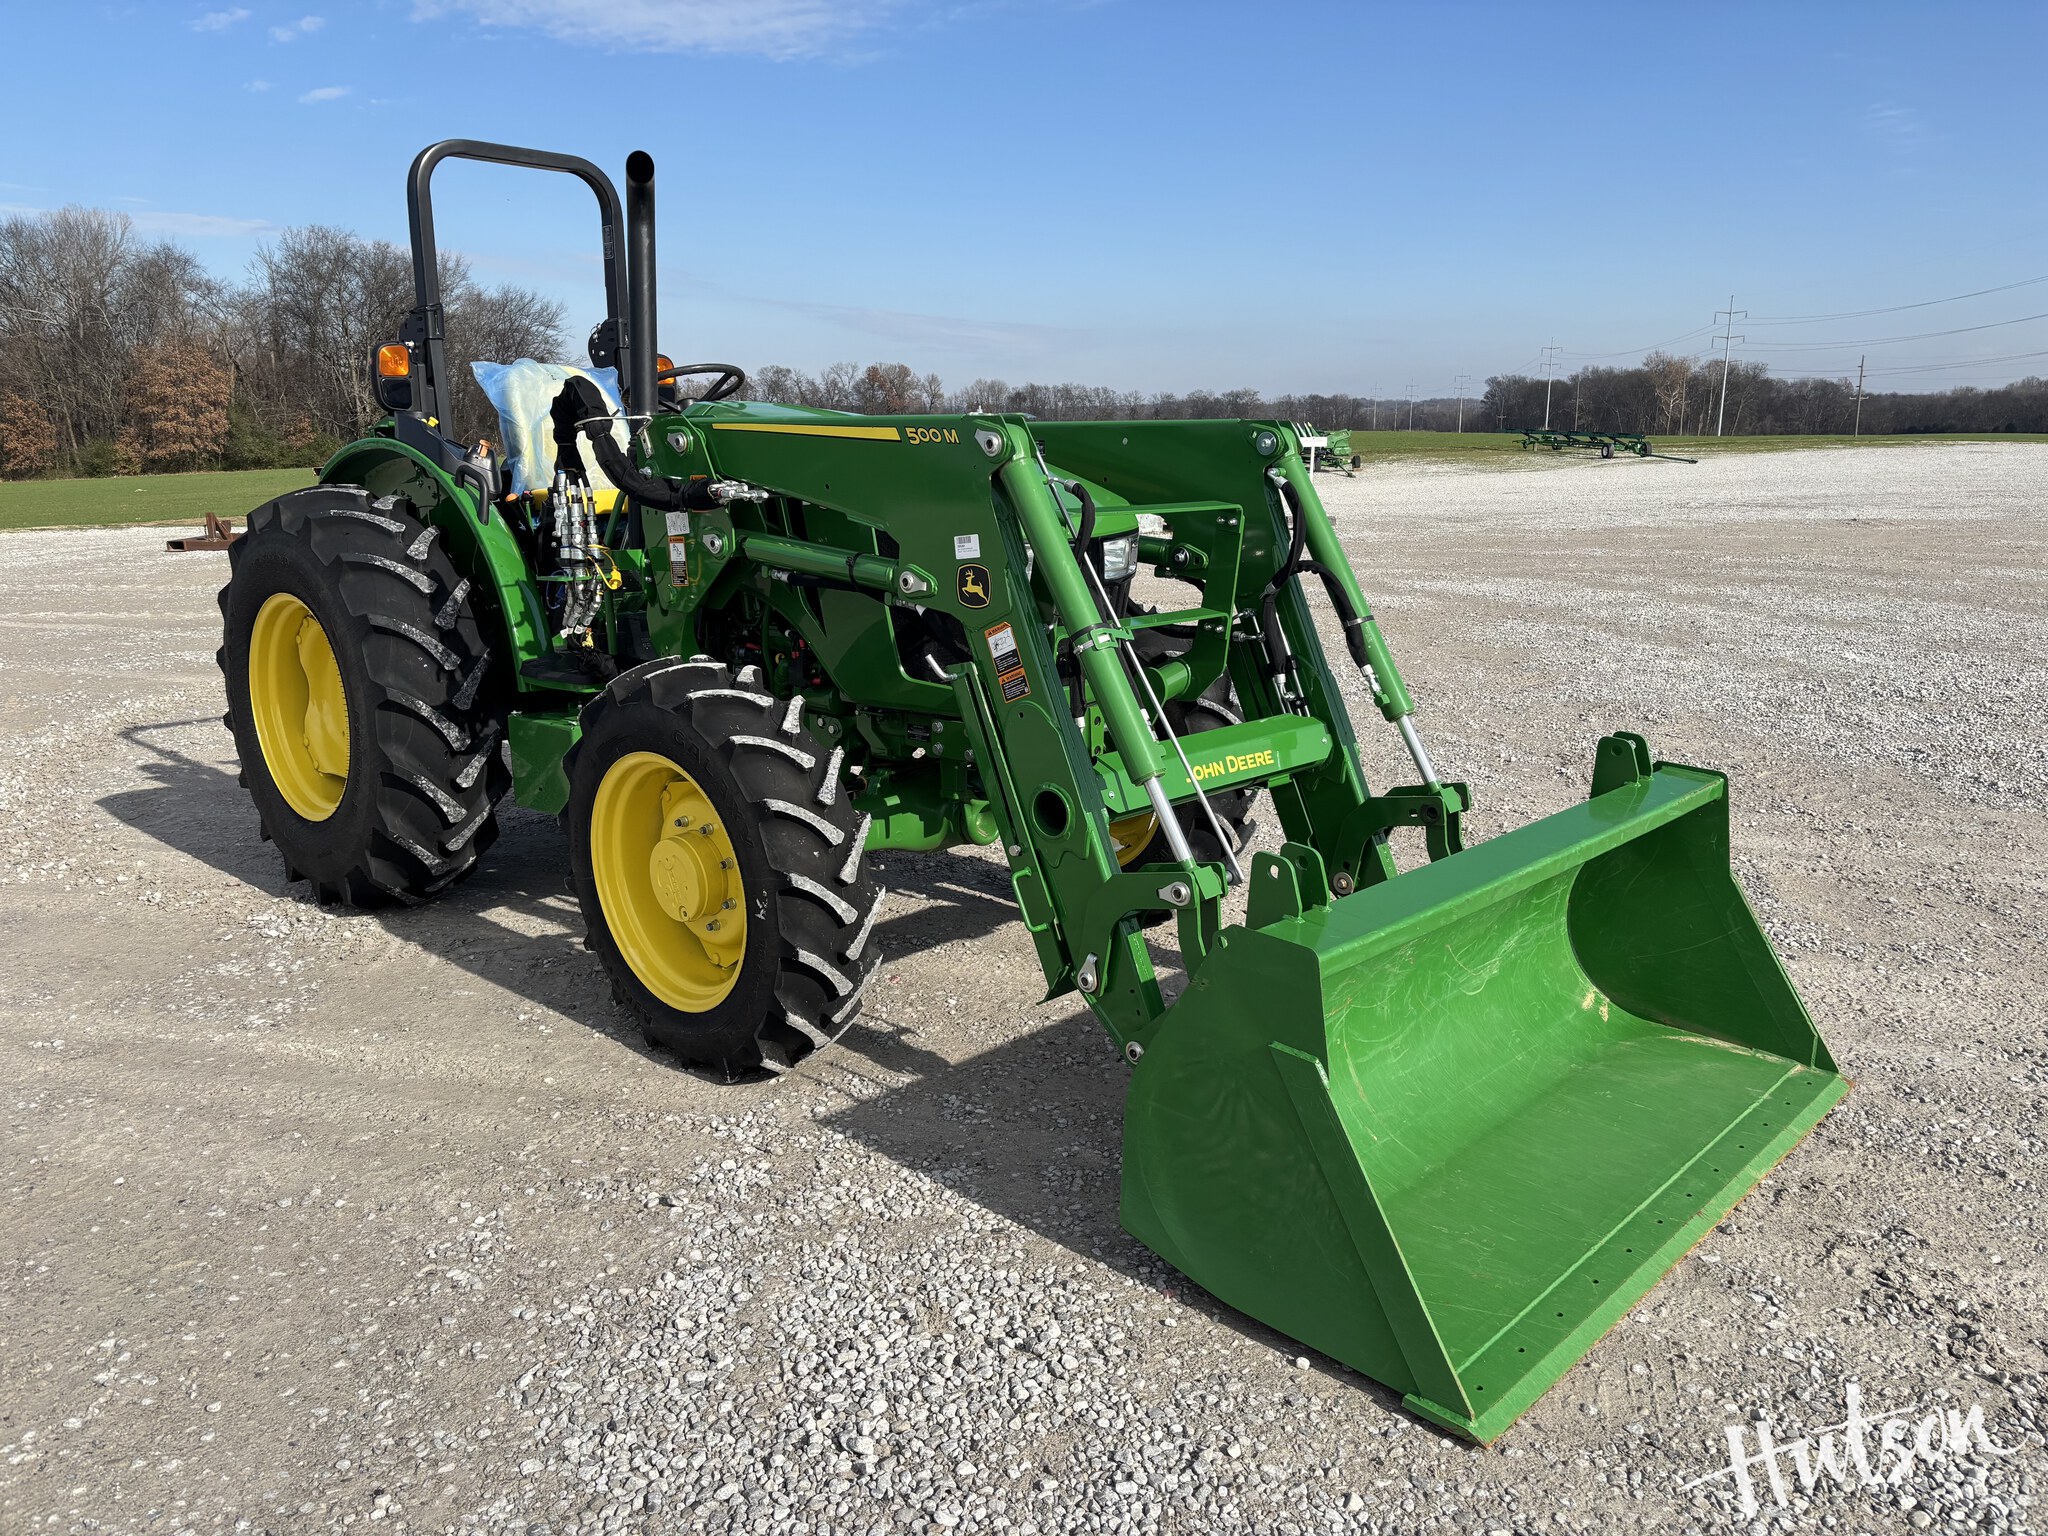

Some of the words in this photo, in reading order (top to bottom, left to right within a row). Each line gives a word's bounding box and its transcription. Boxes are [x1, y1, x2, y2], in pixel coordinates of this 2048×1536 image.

[904, 426, 942, 445] 500
[942, 428, 960, 444] M
[1226, 749, 1275, 774] DEERE
